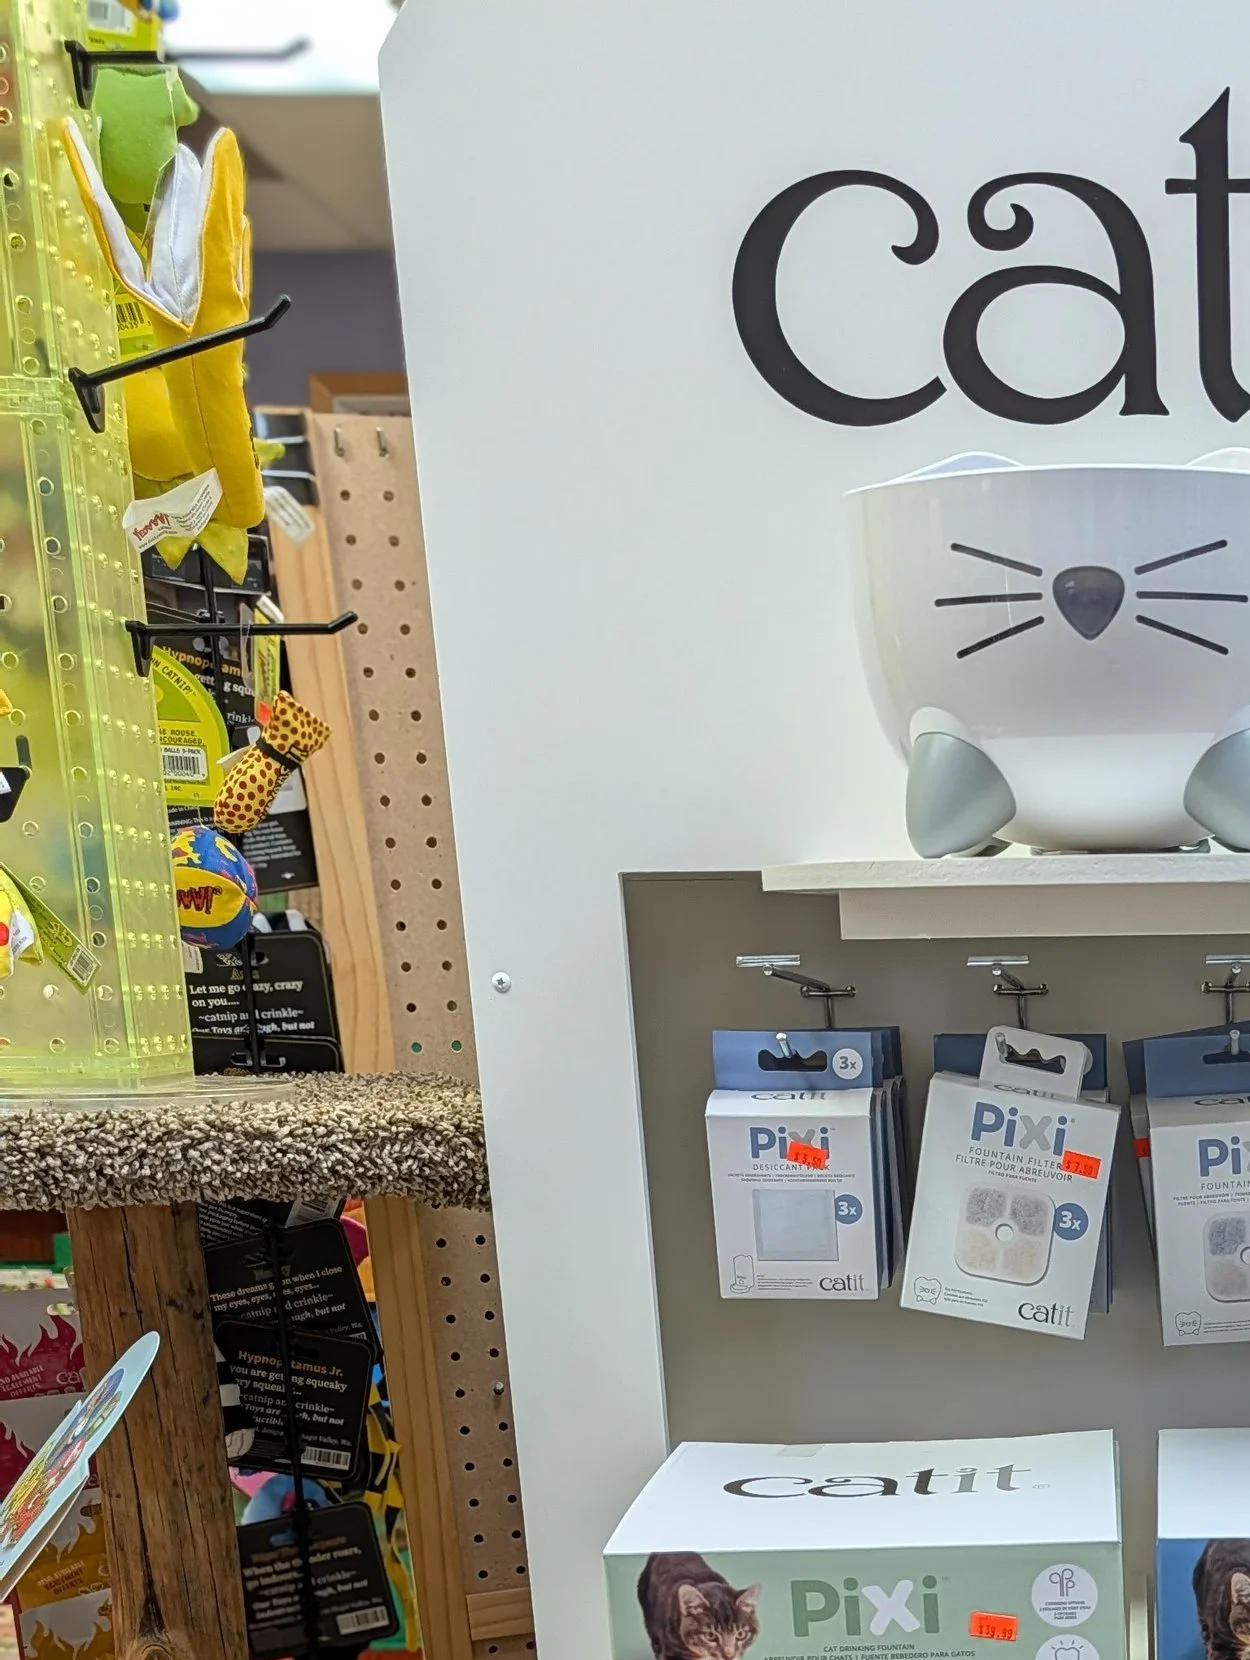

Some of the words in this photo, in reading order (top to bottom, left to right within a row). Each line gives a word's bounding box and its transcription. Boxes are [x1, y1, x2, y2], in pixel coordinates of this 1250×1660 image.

[162, 662, 194, 696] CATNIP!
[190, 984, 207, 995] Let
[209, 985, 225, 994] me
[228, 984, 240, 998] go
[275, 979, 303, 993] crazy
[192, 998, 205, 1007] on
[839, 1056, 857, 1071] 3x
[971, 1101, 1067, 1156] Pixi
[955, 1154, 986, 1166] FILTRE
[990, 1161, 1016, 1172] POUR
[1018, 1166, 1073, 1182] ABREUVOIR
[969, 1147, 1024, 1163] FOUNTAIN
[1028, 1157, 1062, 1170] FILTER
[838, 1202, 857, 1216] 3x
[1059, 1211, 1081, 1231] 3x
[321, 1266, 342, 1276] close
[819, 1275, 865, 1292] catit
[1018, 1302, 1073, 1327] catit
[250, 1369, 267, 1379] are
[306, 1376, 347, 1392] squeaky
[329, 1365, 343, 1377] Jr.
[723, 1463, 1032, 1499] catit
[791, 1575, 940, 1637] Pixi
